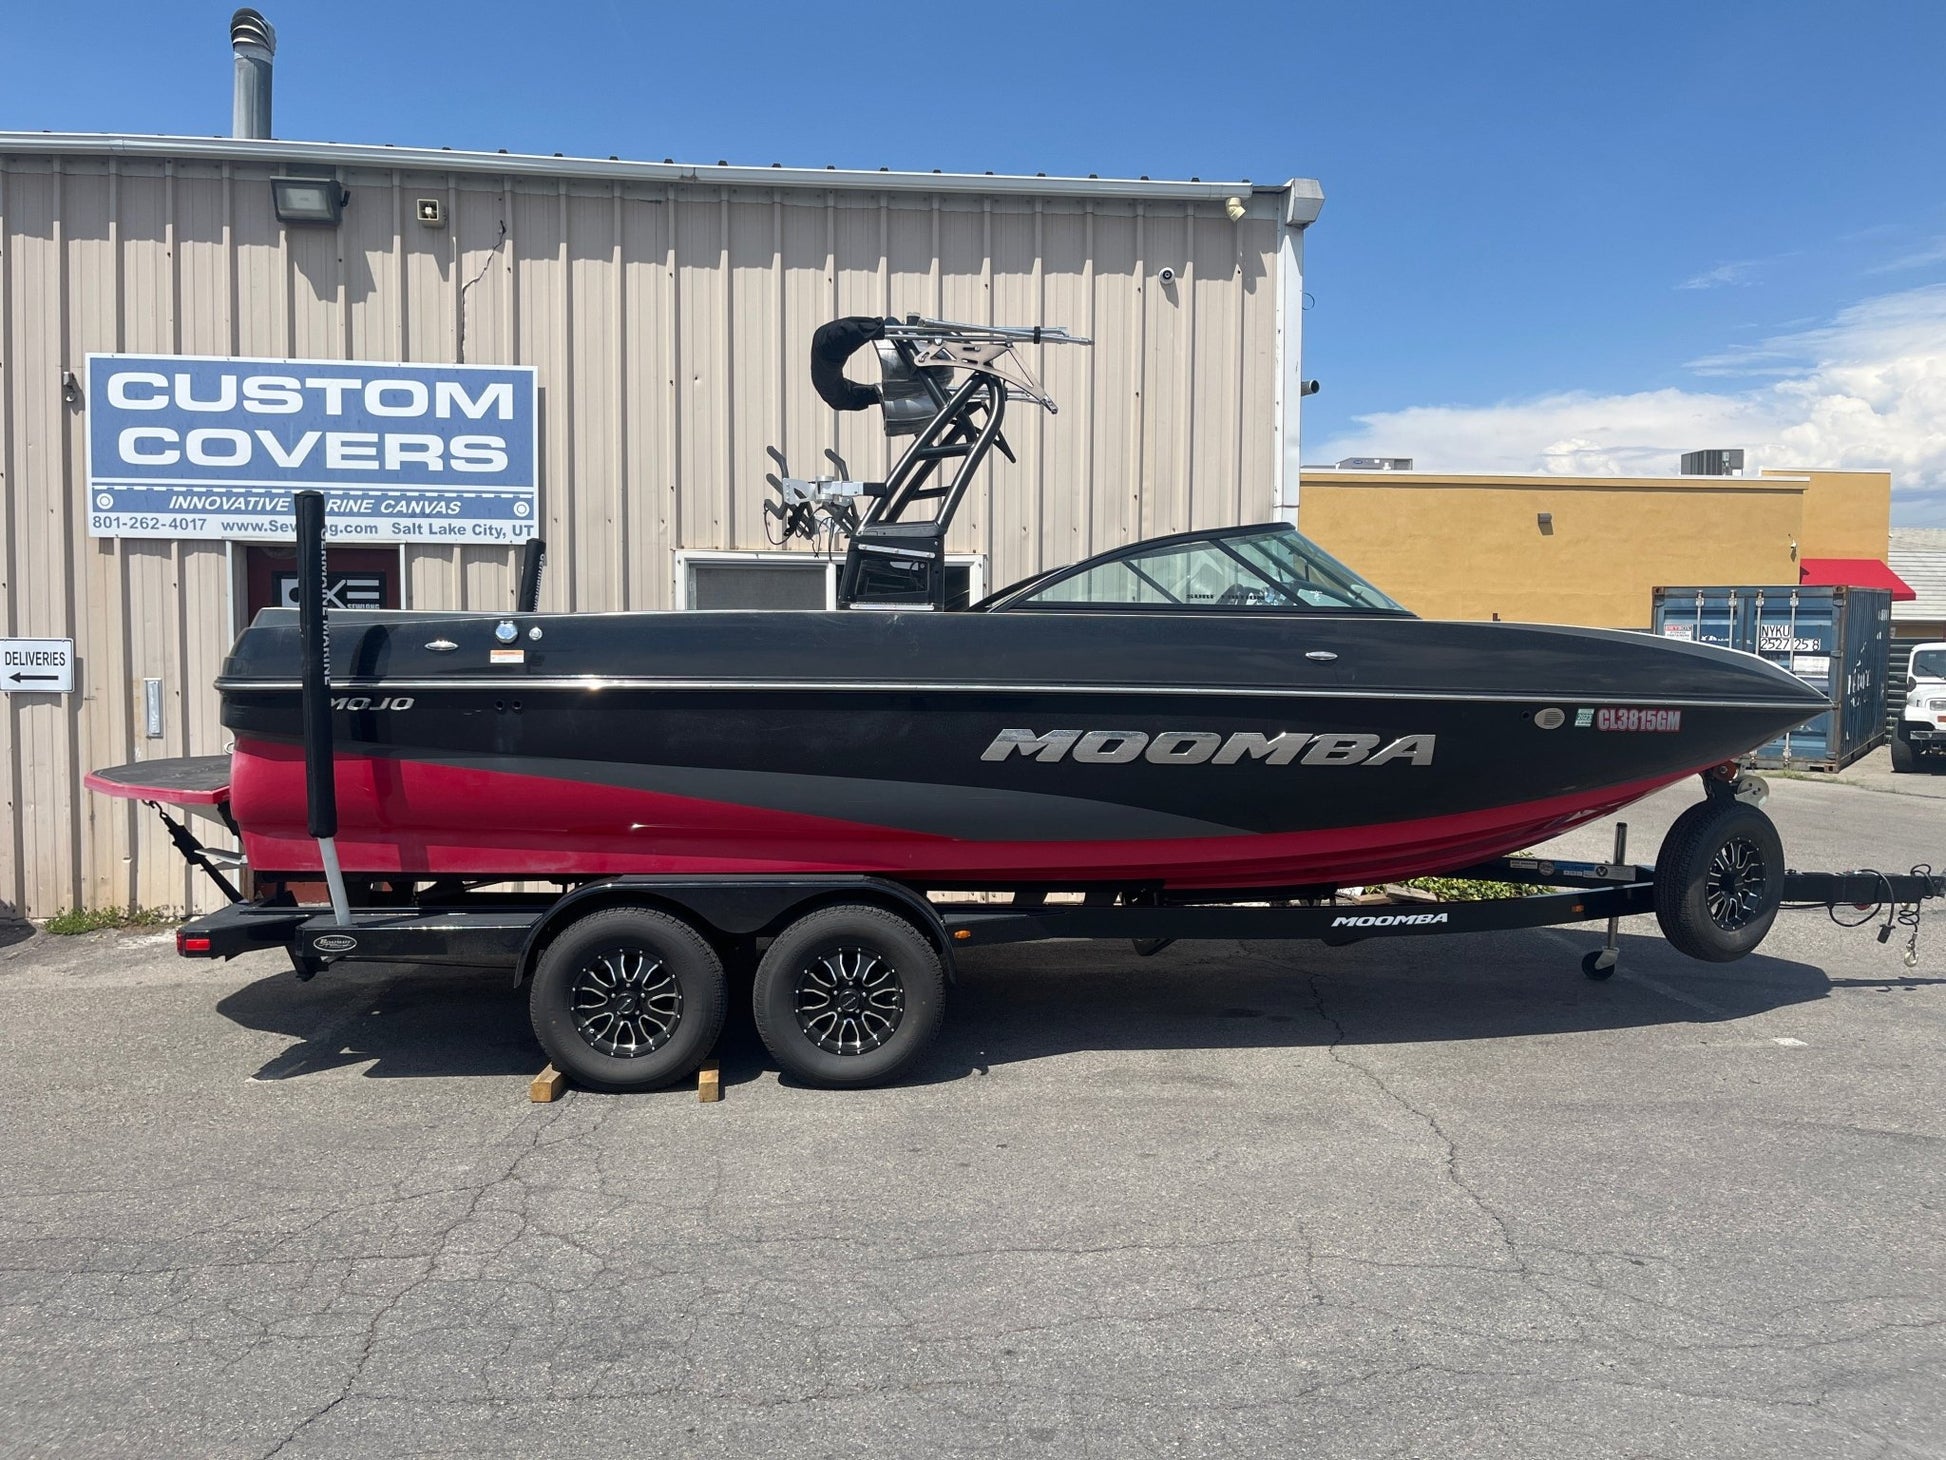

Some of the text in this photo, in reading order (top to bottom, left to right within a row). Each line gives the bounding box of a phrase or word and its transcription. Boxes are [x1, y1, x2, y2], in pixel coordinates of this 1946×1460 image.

[107, 371, 514, 420] CUSTOM
[118, 427, 508, 472] COVERS
[169, 495, 462, 515] INNOVATIVE RINE CANVAS
[92, 515, 207, 531] 801-262-4017
[391, 522, 423, 535] Salt
[429, 523, 466, 536] Lake
[472, 523, 507, 539] City,
[512, 525, 534, 537] UT
[1761, 625, 1791, 638] NYKU
[5, 651, 66, 666] DELIVERIES
[1598, 708, 1681, 731] CL3815GM
[980, 728, 1437, 766] MOOMBA
[1331, 913, 1449, 928] MOOMBA
